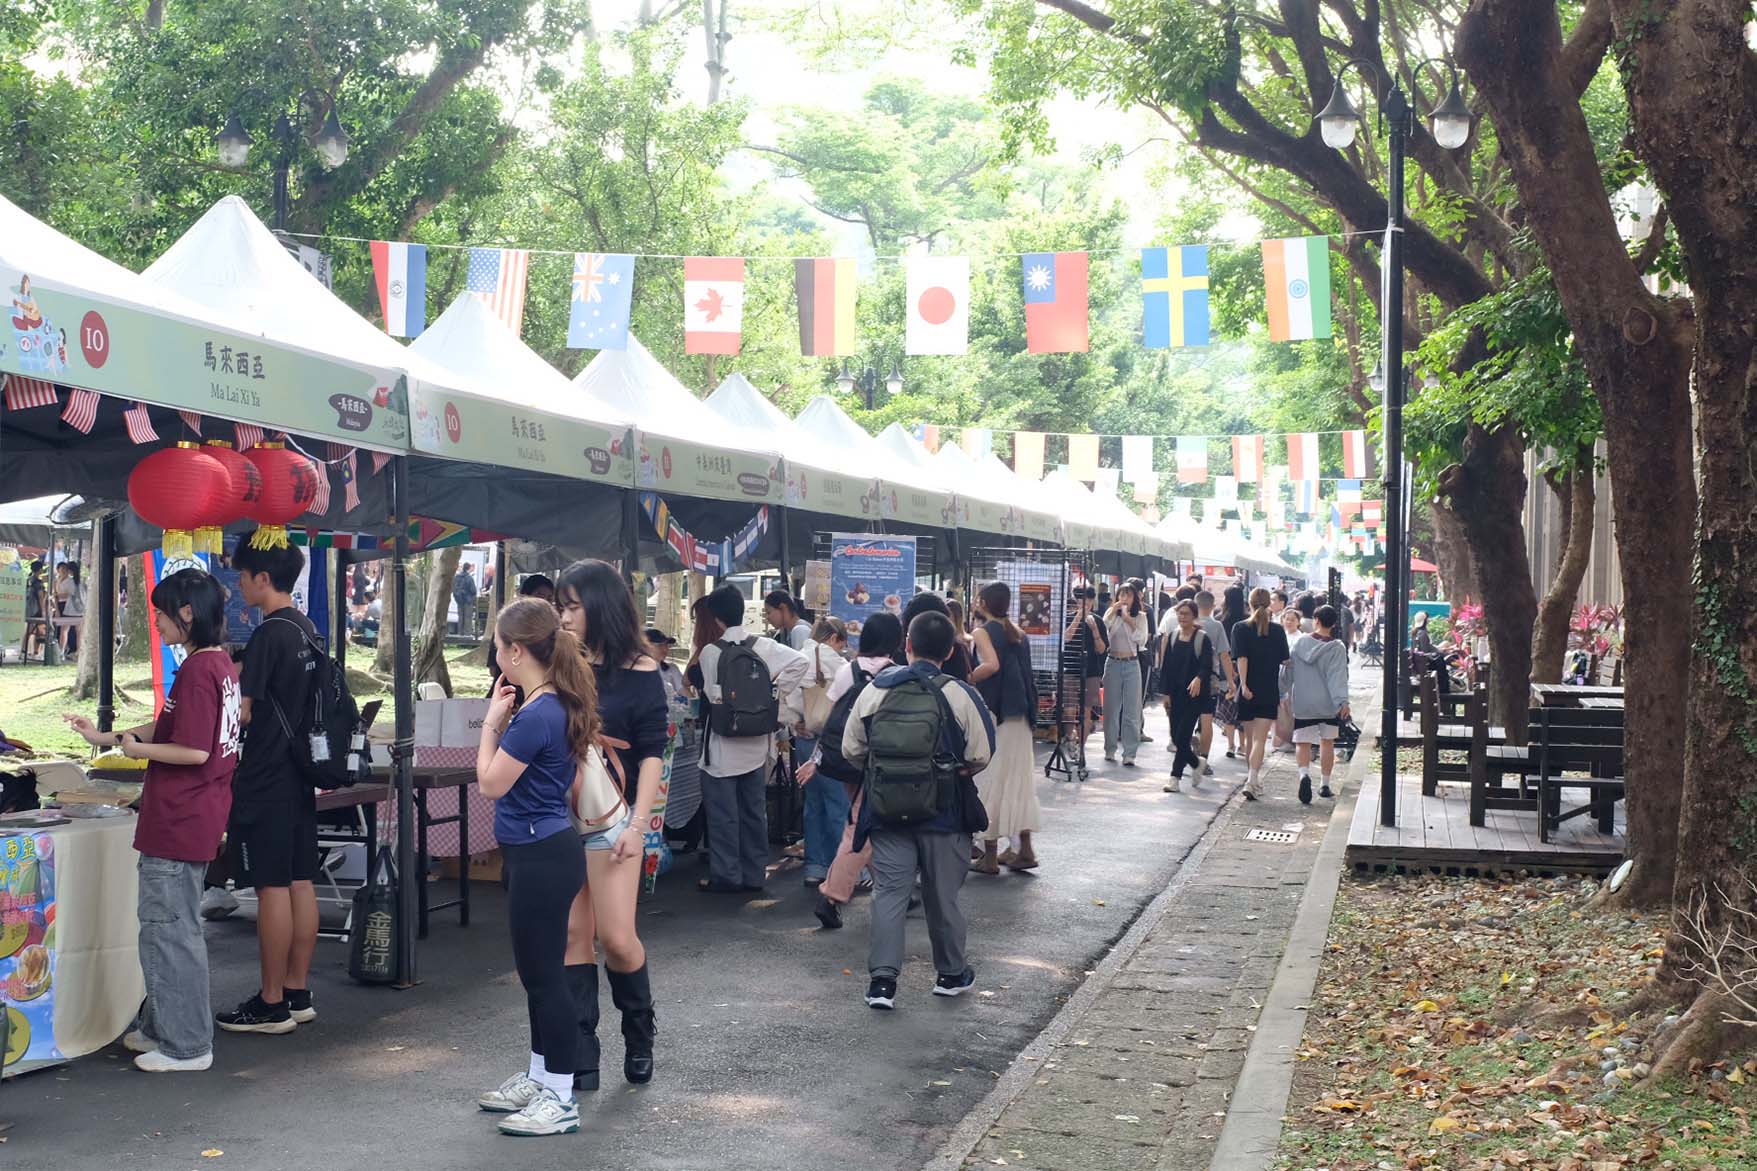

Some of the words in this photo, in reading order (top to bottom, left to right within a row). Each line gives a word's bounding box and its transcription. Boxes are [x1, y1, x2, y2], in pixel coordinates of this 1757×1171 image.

[86, 327, 104, 352] 10
[204, 341, 265, 379] 馬來西亞
[210, 382, 225, 400] Ma
[226, 385, 240, 403] Lai
[240, 388, 250, 405] Xi
[251, 391, 261, 408] Ya
[447, 413, 459, 431] 10
[363, 911, 392, 966] 金馬行
